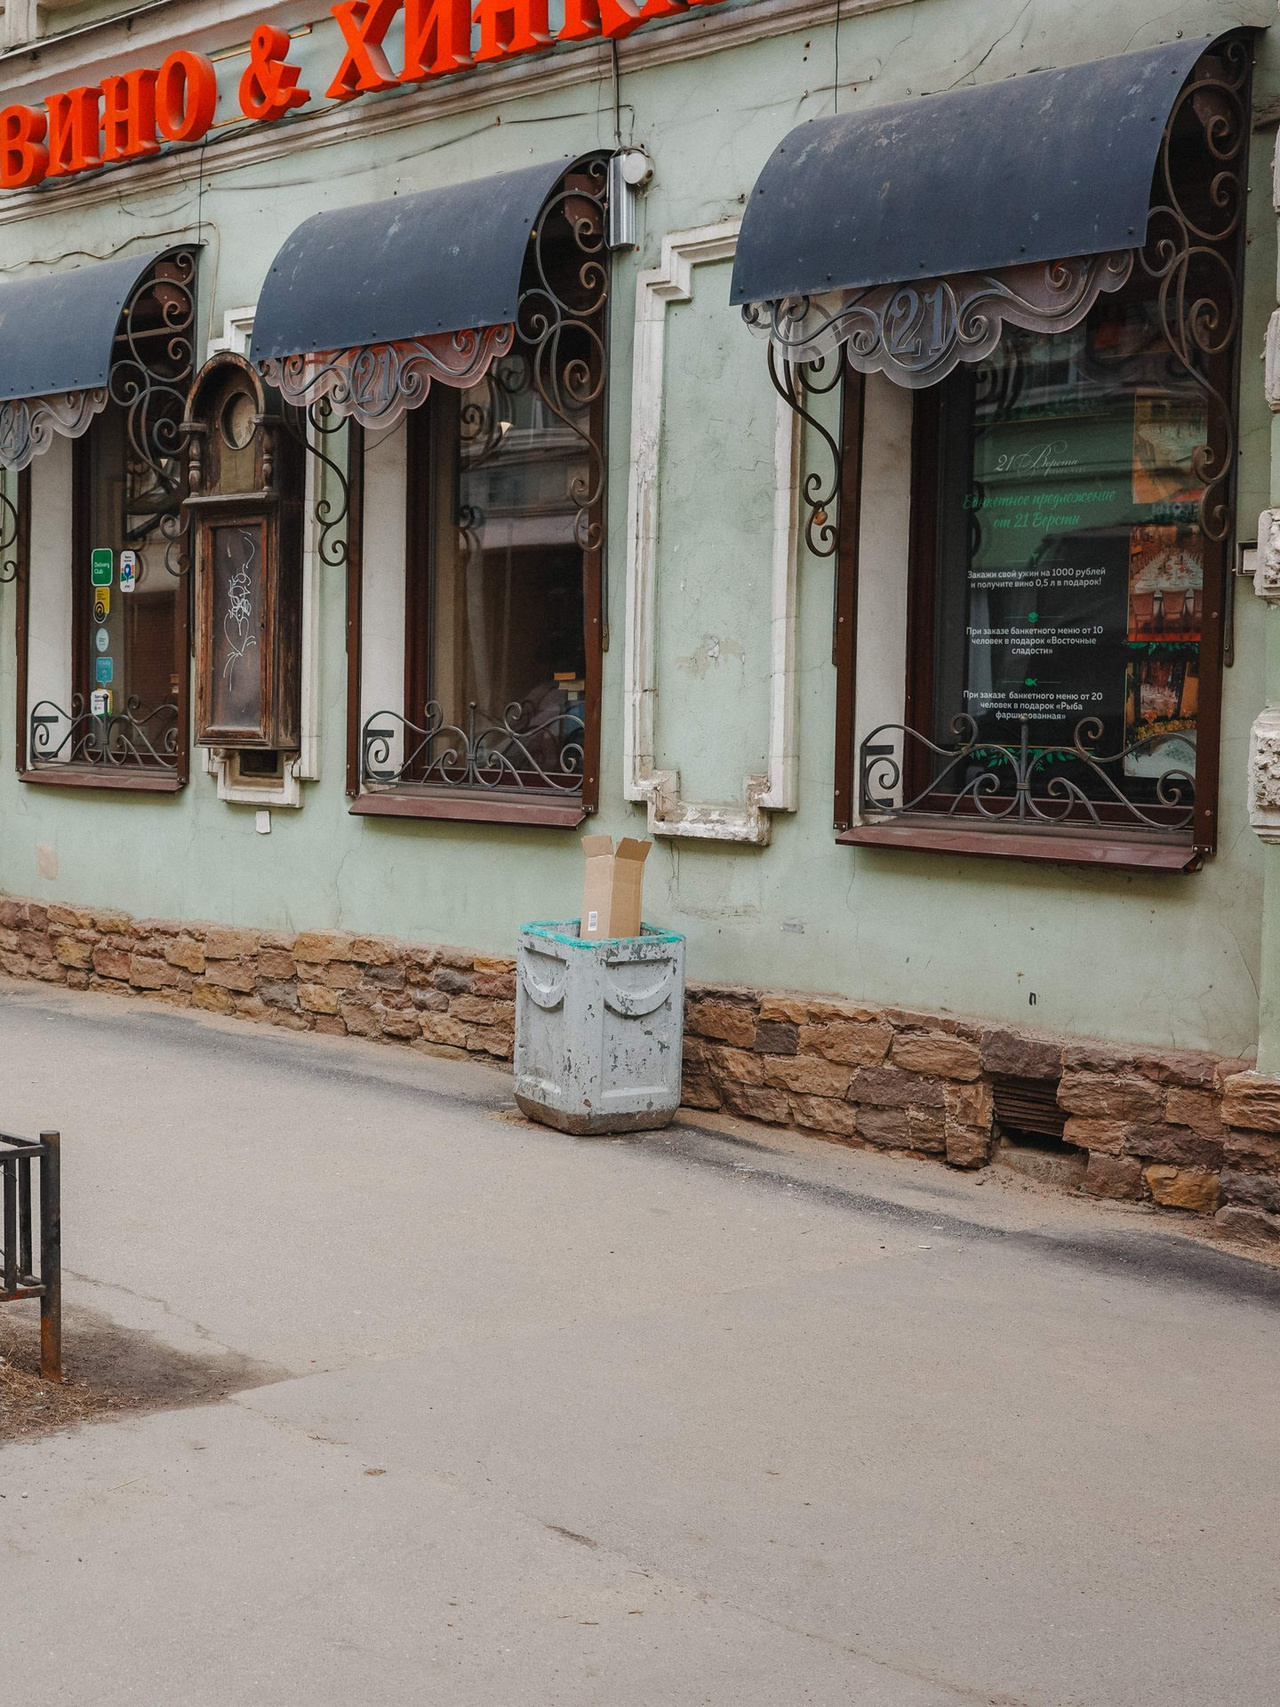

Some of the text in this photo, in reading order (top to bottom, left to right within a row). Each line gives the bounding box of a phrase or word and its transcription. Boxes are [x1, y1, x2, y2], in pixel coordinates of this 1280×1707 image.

[238, 24, 311, 121] &
[994, 454, 1016, 472] 21
[1014, 513, 1029, 528] 21
[967, 571, 997, 579] Закажи
[998, 570, 1017, 578] свой
[1018, 571, 1039, 579] ужин
[1052, 568, 1074, 577] 1000
[1075, 567, 1106, 578] рублей
[977, 581, 1013, 590] получите
[1035, 579, 1049, 588] 0,5
[1063, 577, 1102, 588] подарок!
[966, 627, 982, 637] При
[1010, 627, 1056, 635] банкетного
[1057, 627, 1081, 635] меню
[1093, 626, 1104, 634] 10
[1010, 637, 1045, 646] подарок
[1046, 636, 1097, 645] «Восточные
[1011, 647, 1054, 656] сладости»
[963, 690, 979, 700] При
[1009, 690, 1055, 700] банкетного
[1091, 692, 1103, 701] 20
[980, 701, 1012, 709] человек
[1019, 702, 1055, 711] подарок
[1056, 701, 1083, 710] «Рыба
